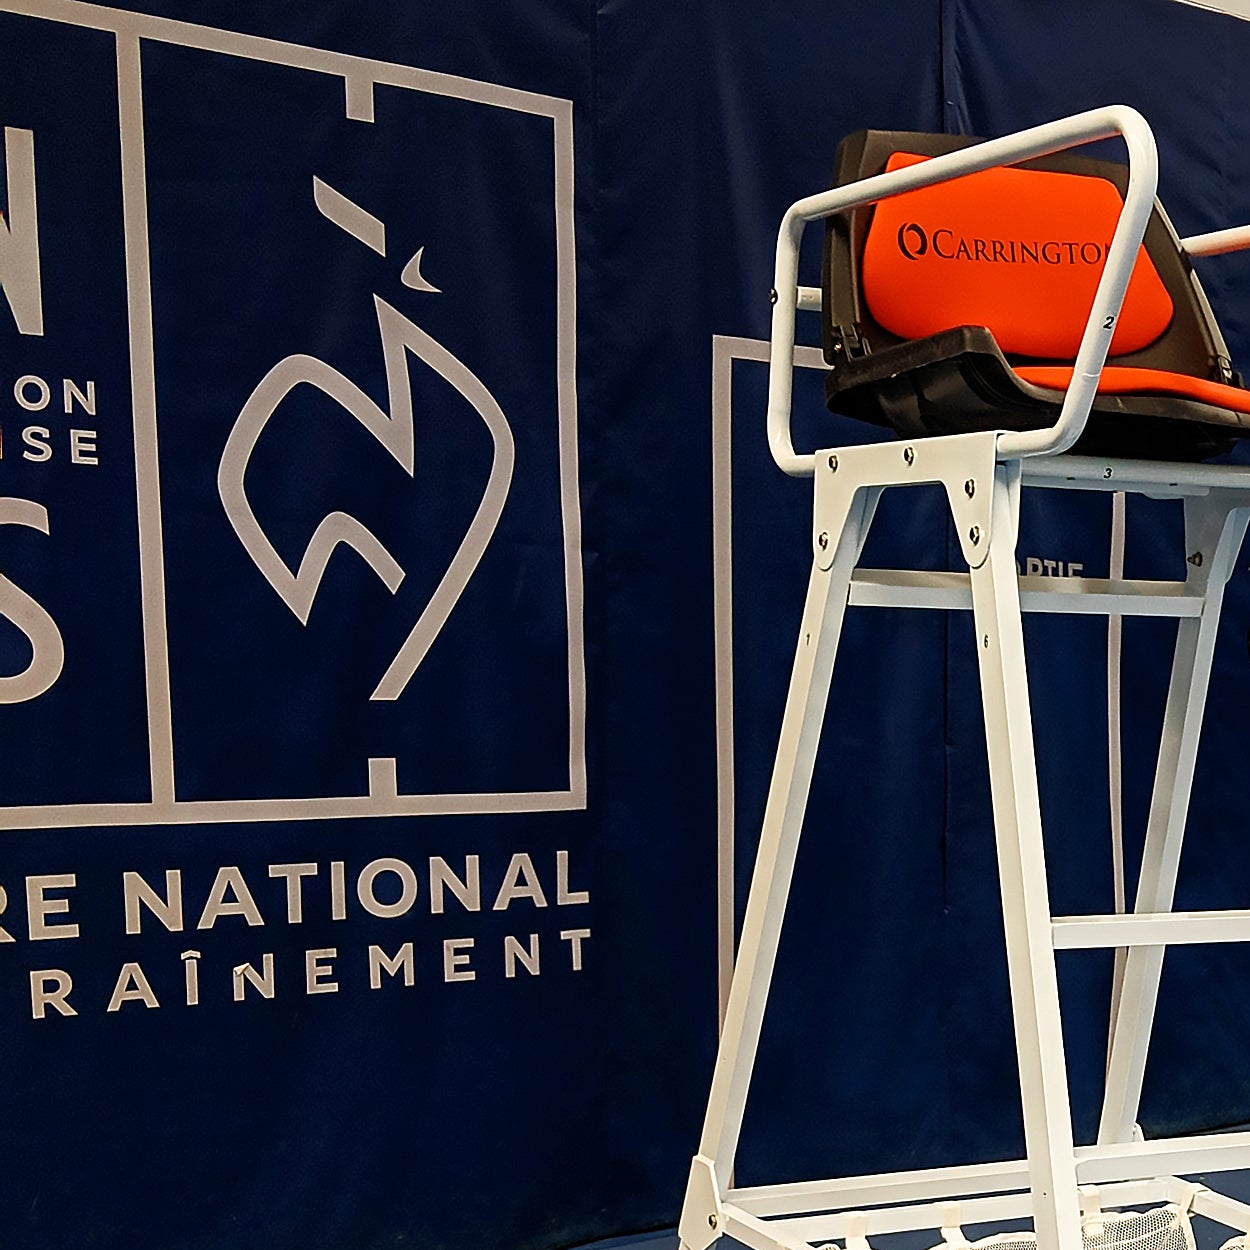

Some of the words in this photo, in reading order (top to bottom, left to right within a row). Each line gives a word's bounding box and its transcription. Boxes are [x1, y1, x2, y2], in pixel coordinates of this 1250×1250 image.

[1103, 315, 1115, 330] 2
[0, 426, 99, 466] SE
[1103, 467, 1113, 480] 3
[805, 633, 811, 647] 1
[983, 635, 989, 648] 6
[123, 850, 590, 935] NATIONAL
[29, 928, 591, 1020] RAÎNEMENT
